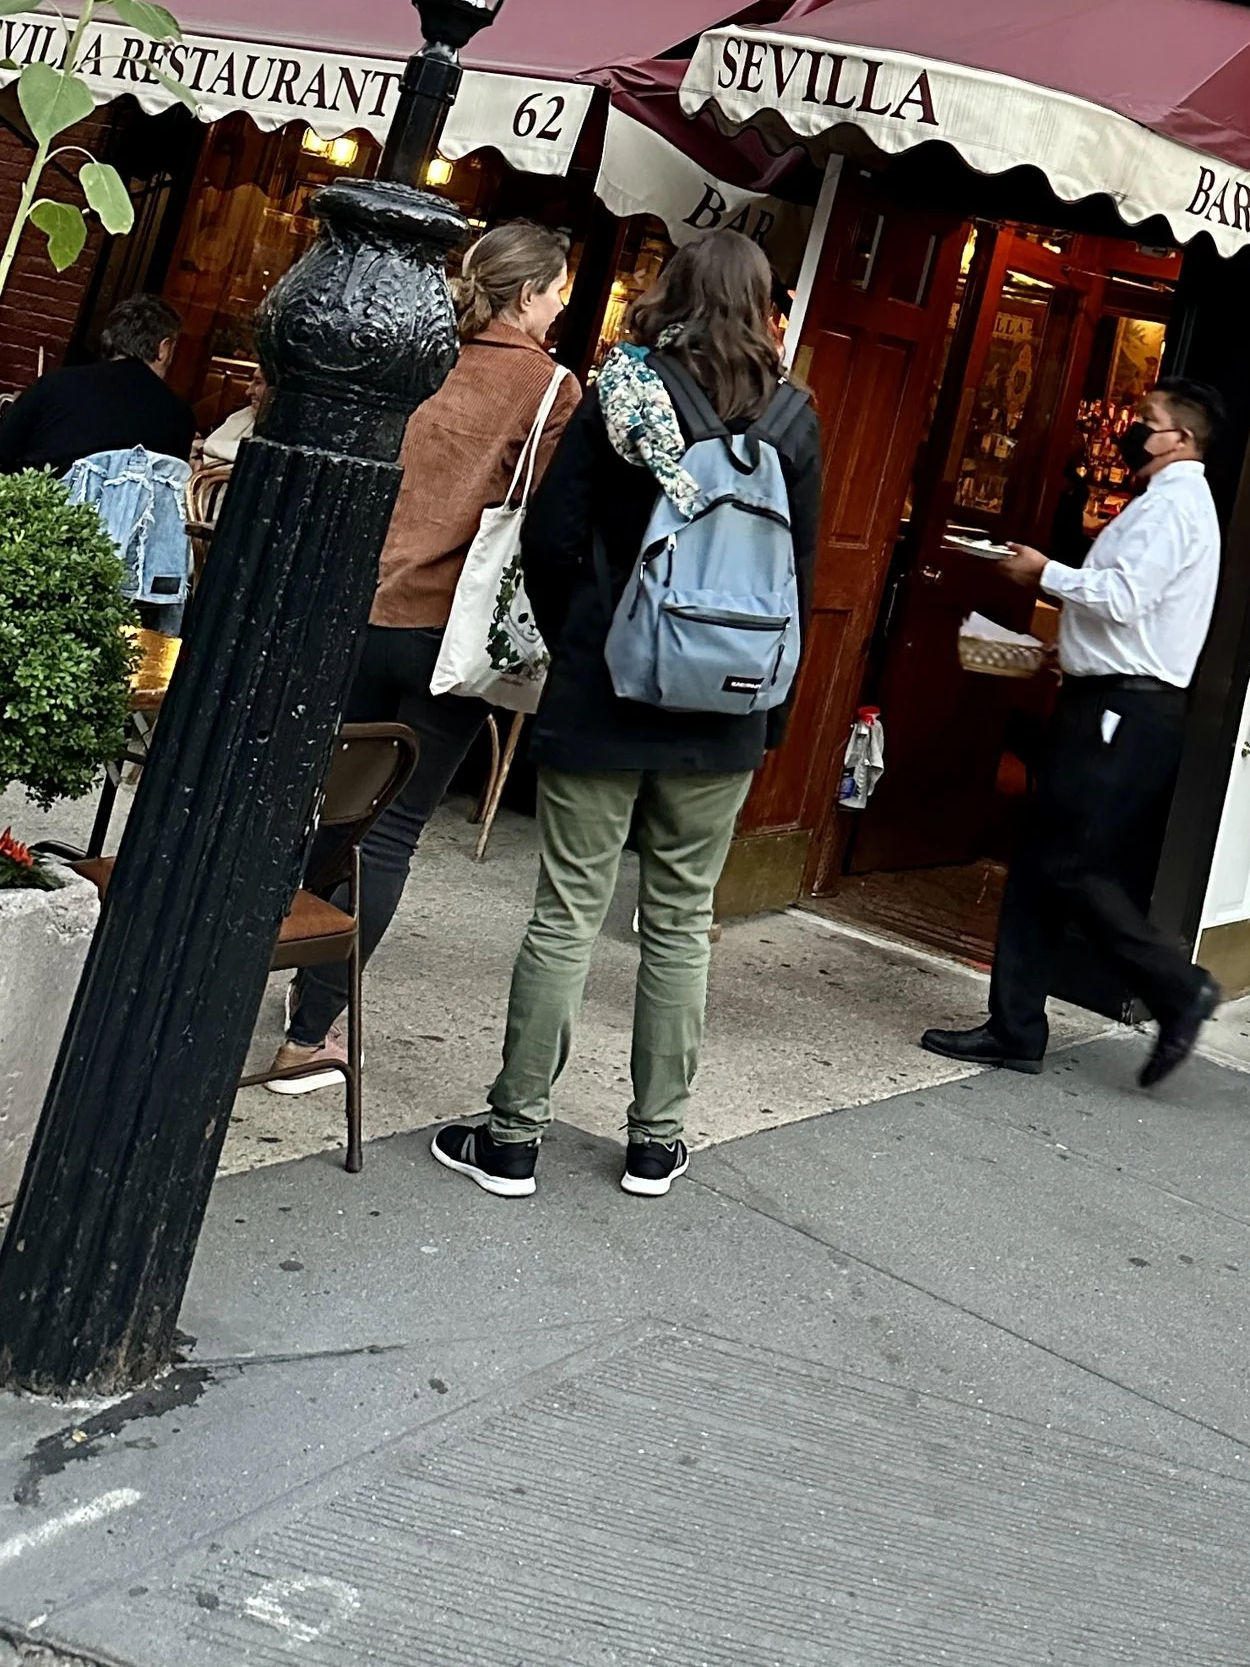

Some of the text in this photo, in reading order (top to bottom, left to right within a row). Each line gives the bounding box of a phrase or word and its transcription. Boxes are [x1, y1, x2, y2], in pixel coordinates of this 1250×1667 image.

[116, 37, 402, 118] RESTAURANT
[717, 36, 940, 127] SEVILLA
[512, 92, 566, 143] 62
[682, 181, 776, 251] BAR
